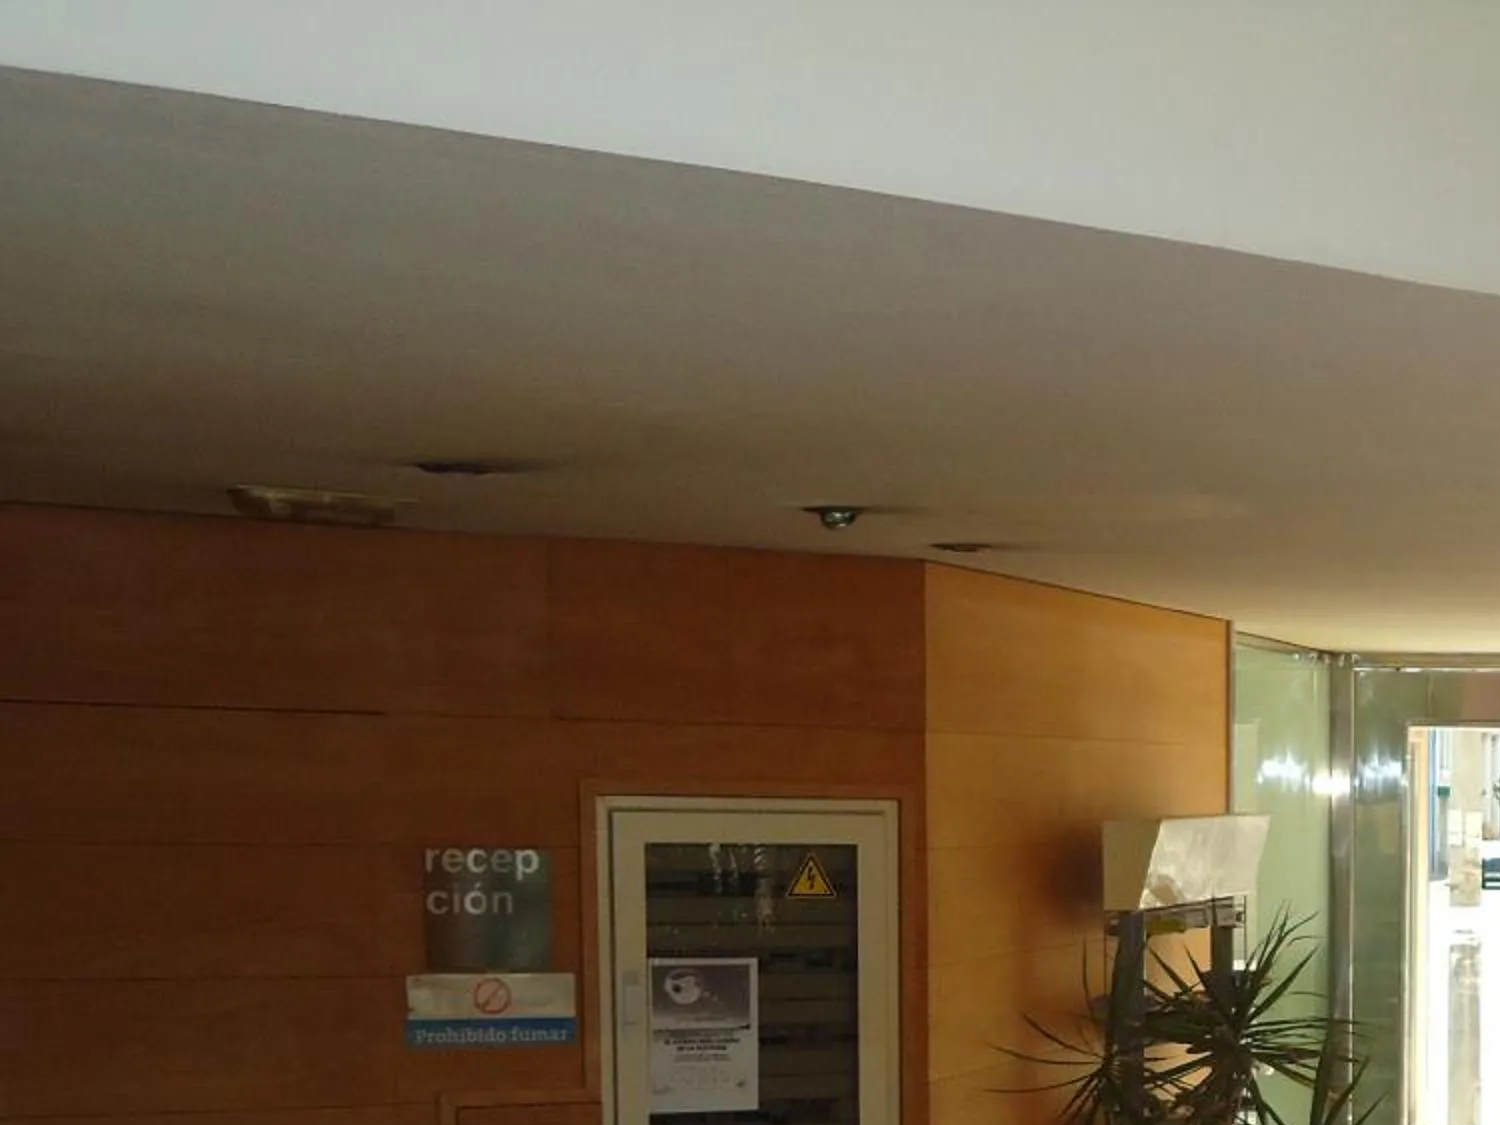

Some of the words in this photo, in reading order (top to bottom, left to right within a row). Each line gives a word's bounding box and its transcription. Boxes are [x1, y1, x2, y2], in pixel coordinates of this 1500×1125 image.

[424, 847, 540, 881] recep
[426, 881, 513, 915] ción
[415, 1025, 507, 1044] Prohibido
[510, 1024, 567, 1043] fumar
